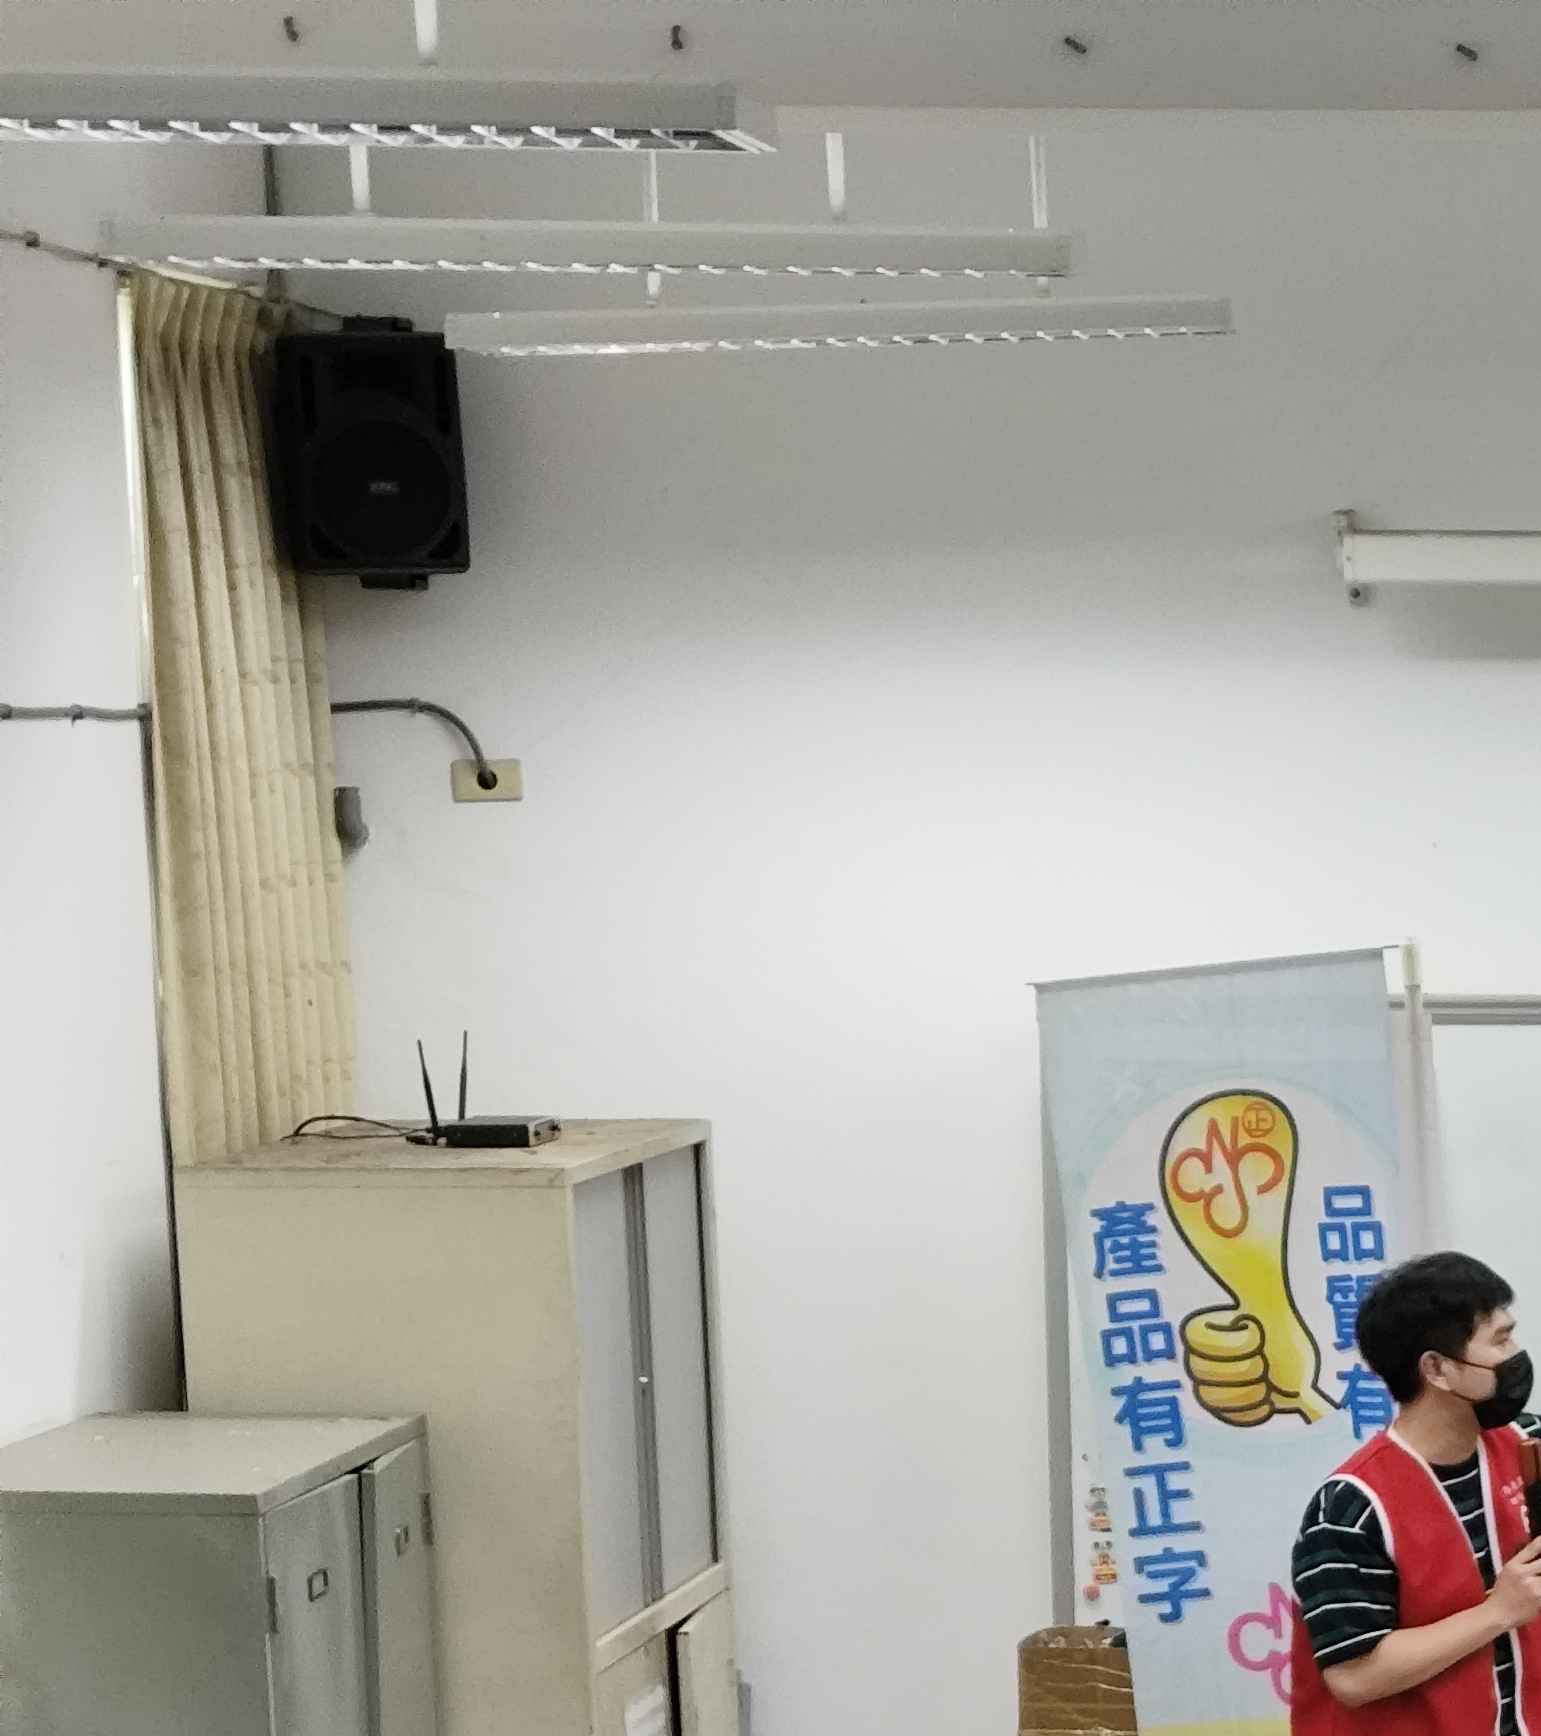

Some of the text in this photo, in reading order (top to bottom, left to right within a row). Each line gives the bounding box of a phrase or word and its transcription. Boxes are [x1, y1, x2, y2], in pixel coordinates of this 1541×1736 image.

[1090, 1200, 1213, 1624] 產品有正字
